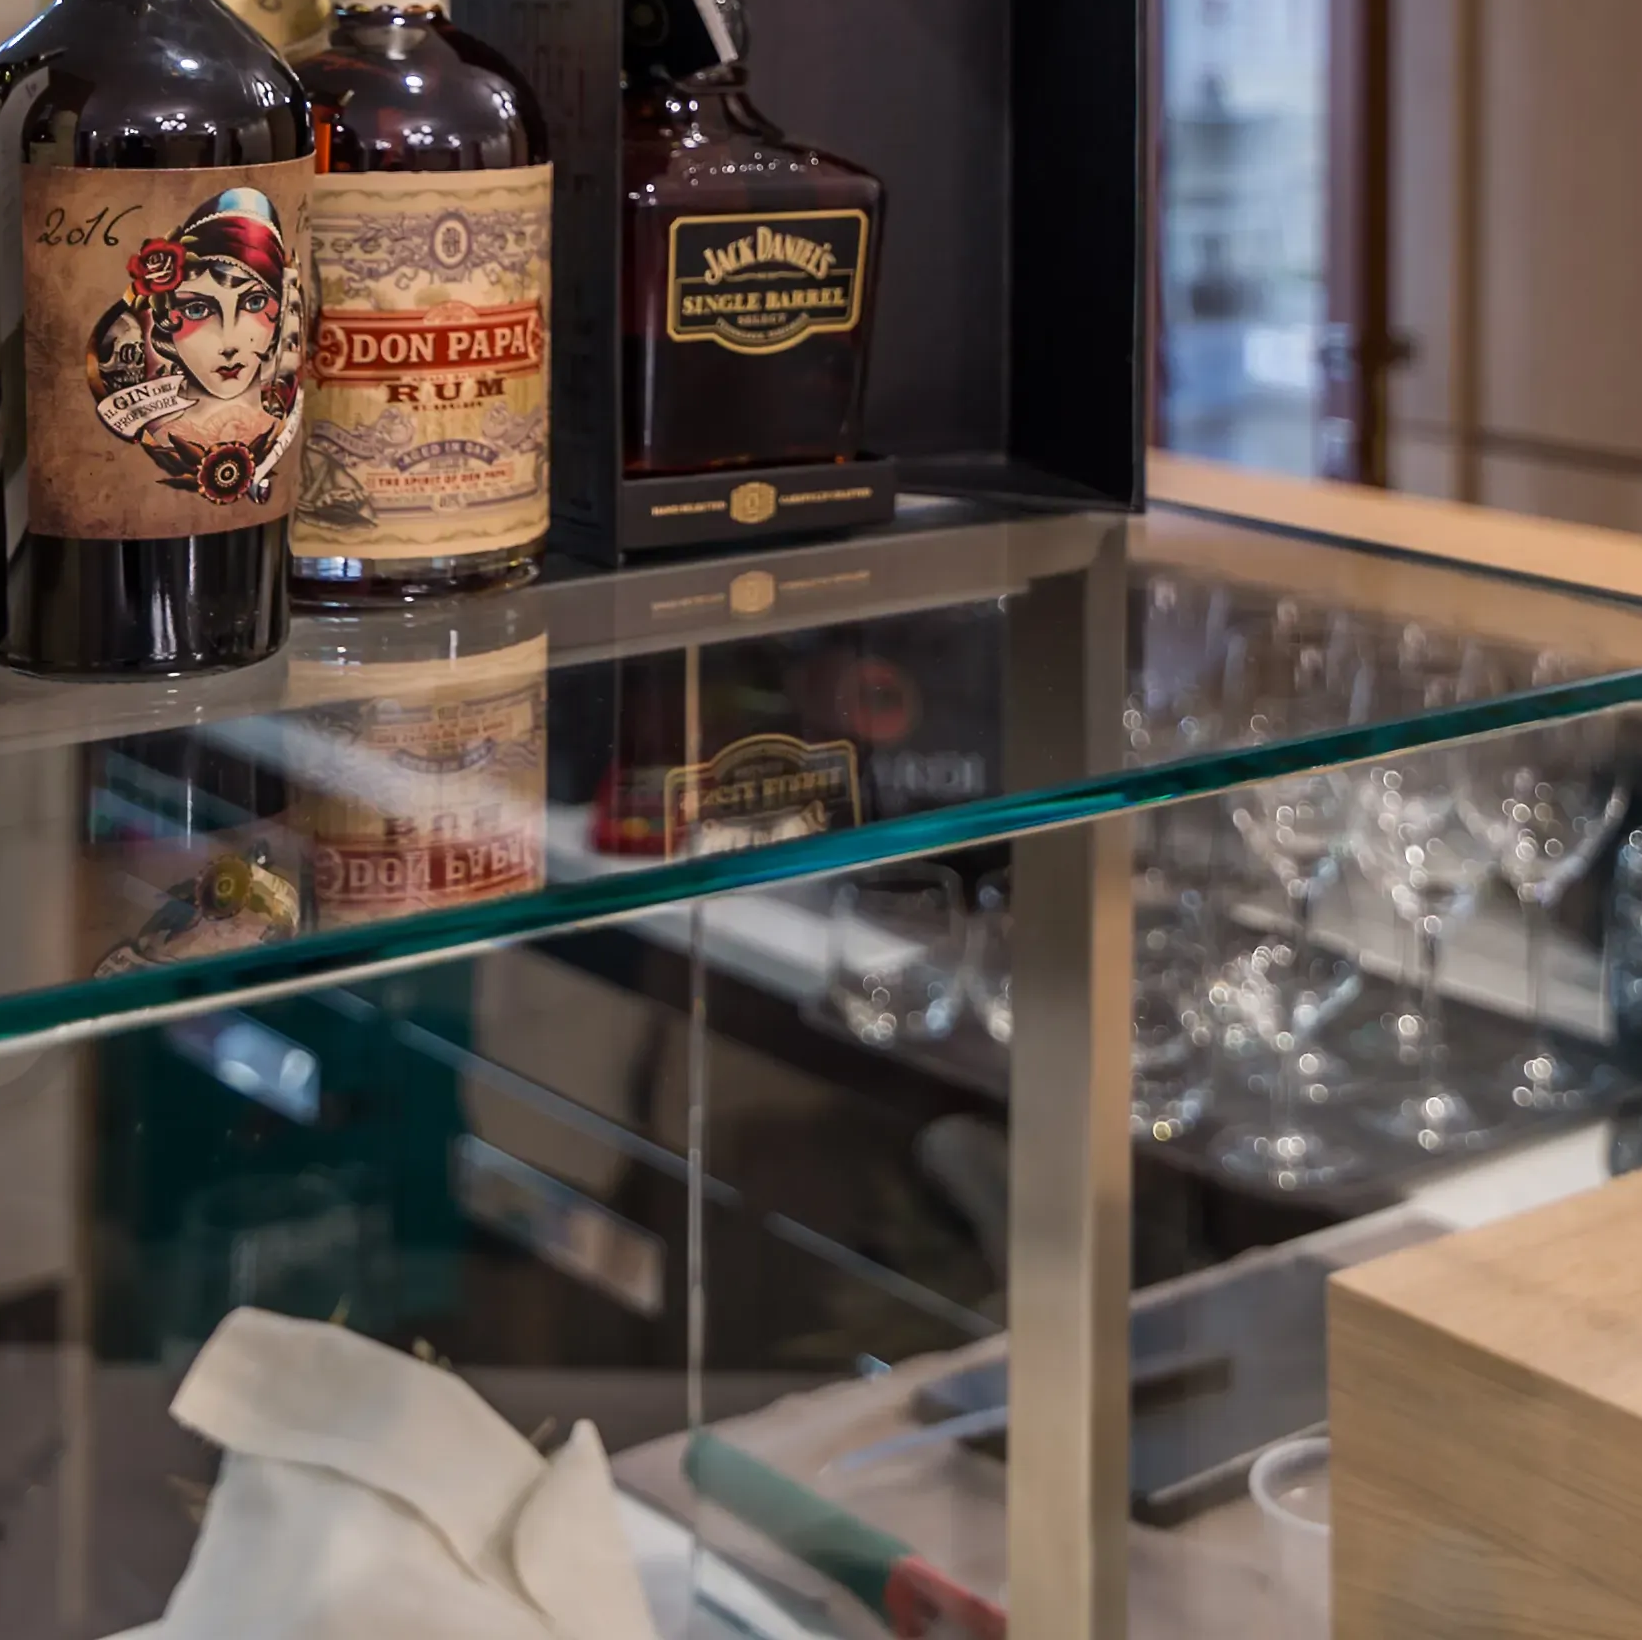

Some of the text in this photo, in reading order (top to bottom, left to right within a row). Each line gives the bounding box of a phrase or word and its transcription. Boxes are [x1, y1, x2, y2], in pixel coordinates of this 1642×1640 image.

[37, 204, 143, 248] 2016
[703, 236, 756, 286] JACK
[681, 286, 847, 316] SINGLE BARREL
[351, 324, 527, 364] DON PAPA
[113, 382, 177, 410] GIN DEL
[386, 377, 506, 403] RUM
